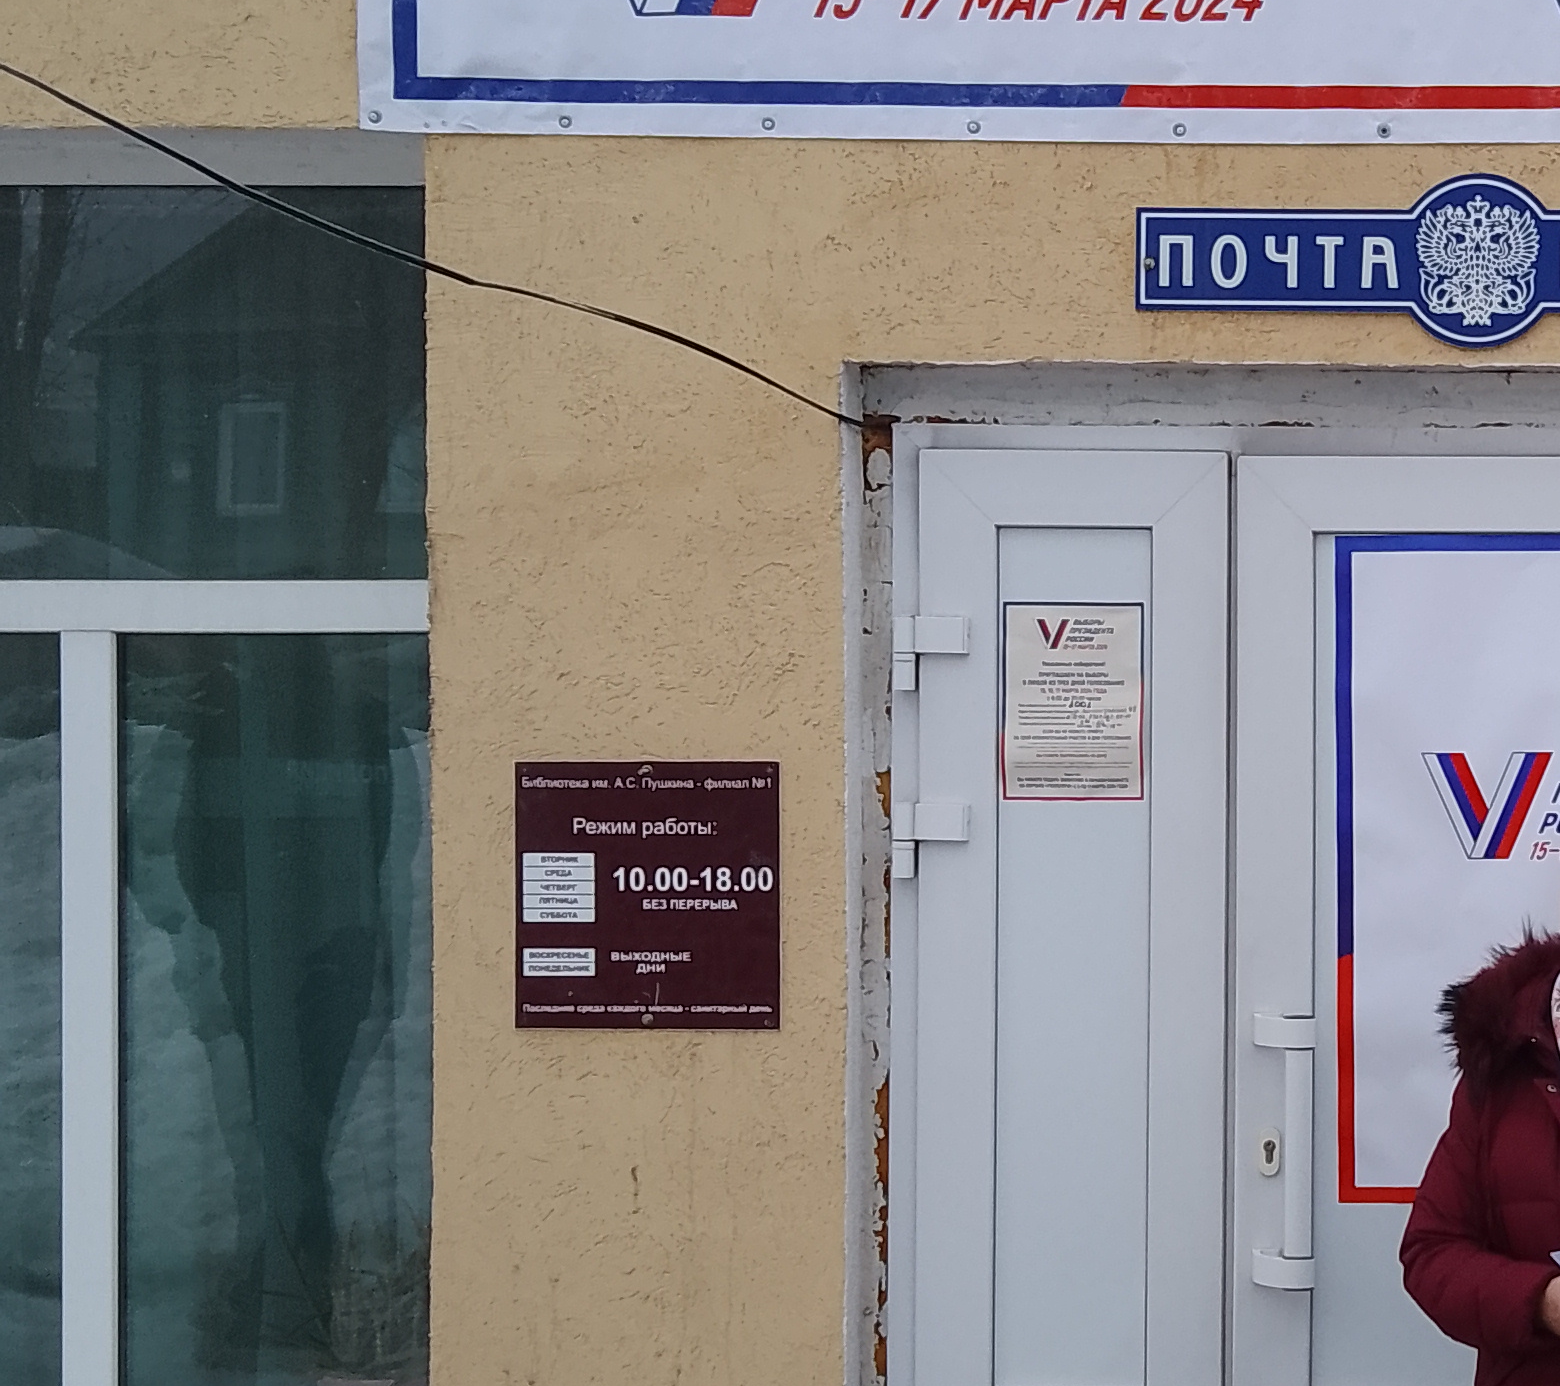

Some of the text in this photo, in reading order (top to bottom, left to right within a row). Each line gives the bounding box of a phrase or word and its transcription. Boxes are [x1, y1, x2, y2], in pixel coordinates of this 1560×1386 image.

[1157, 234, 1400, 289] ПОЧТА
[521, 776, 590, 790] Библиотека
[641, 776, 694, 792] Пушкина
[704, 777, 749, 792] филиал
[572, 817, 718, 838] Режим работы:
[540, 855, 579, 865] ВТОРНИК
[544, 869, 573, 879] СРЕДА
[613, 866, 774, 893] 10.00-18.00
[540, 883, 577, 893] ЧЕТВЕРГ
[539, 897, 579, 907] ПЯТНИЦА
[642, 899, 738, 911] БЕЗ ПЕРЕРЫВА
[539, 910, 579, 920] СУББОТА
[610, 951, 692, 963] ВЫХОДНЫЕ
[636, 963, 666, 974] ДНИ
